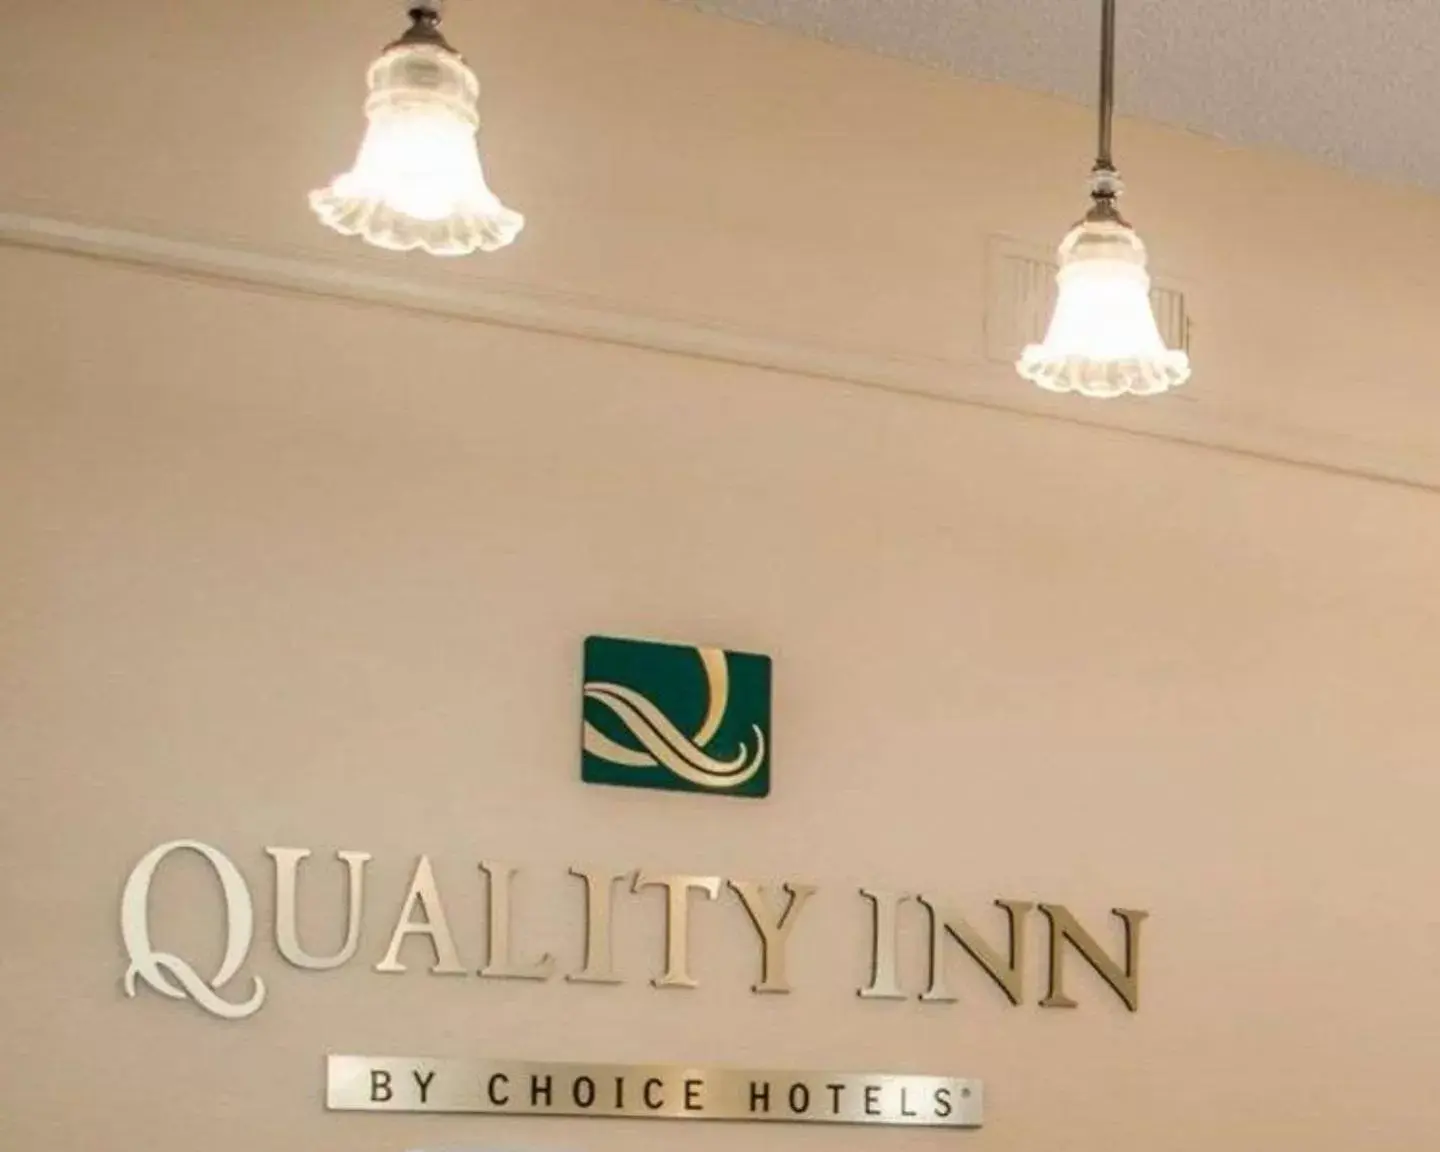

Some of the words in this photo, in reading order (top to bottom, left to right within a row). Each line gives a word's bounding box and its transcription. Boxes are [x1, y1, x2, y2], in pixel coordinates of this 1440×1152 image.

[117, 839, 818, 1019] QUALITY
[856, 887, 1150, 1013] INN
[369, 1069, 435, 1104] BY
[487, 1072, 705, 1111] CHOICE
